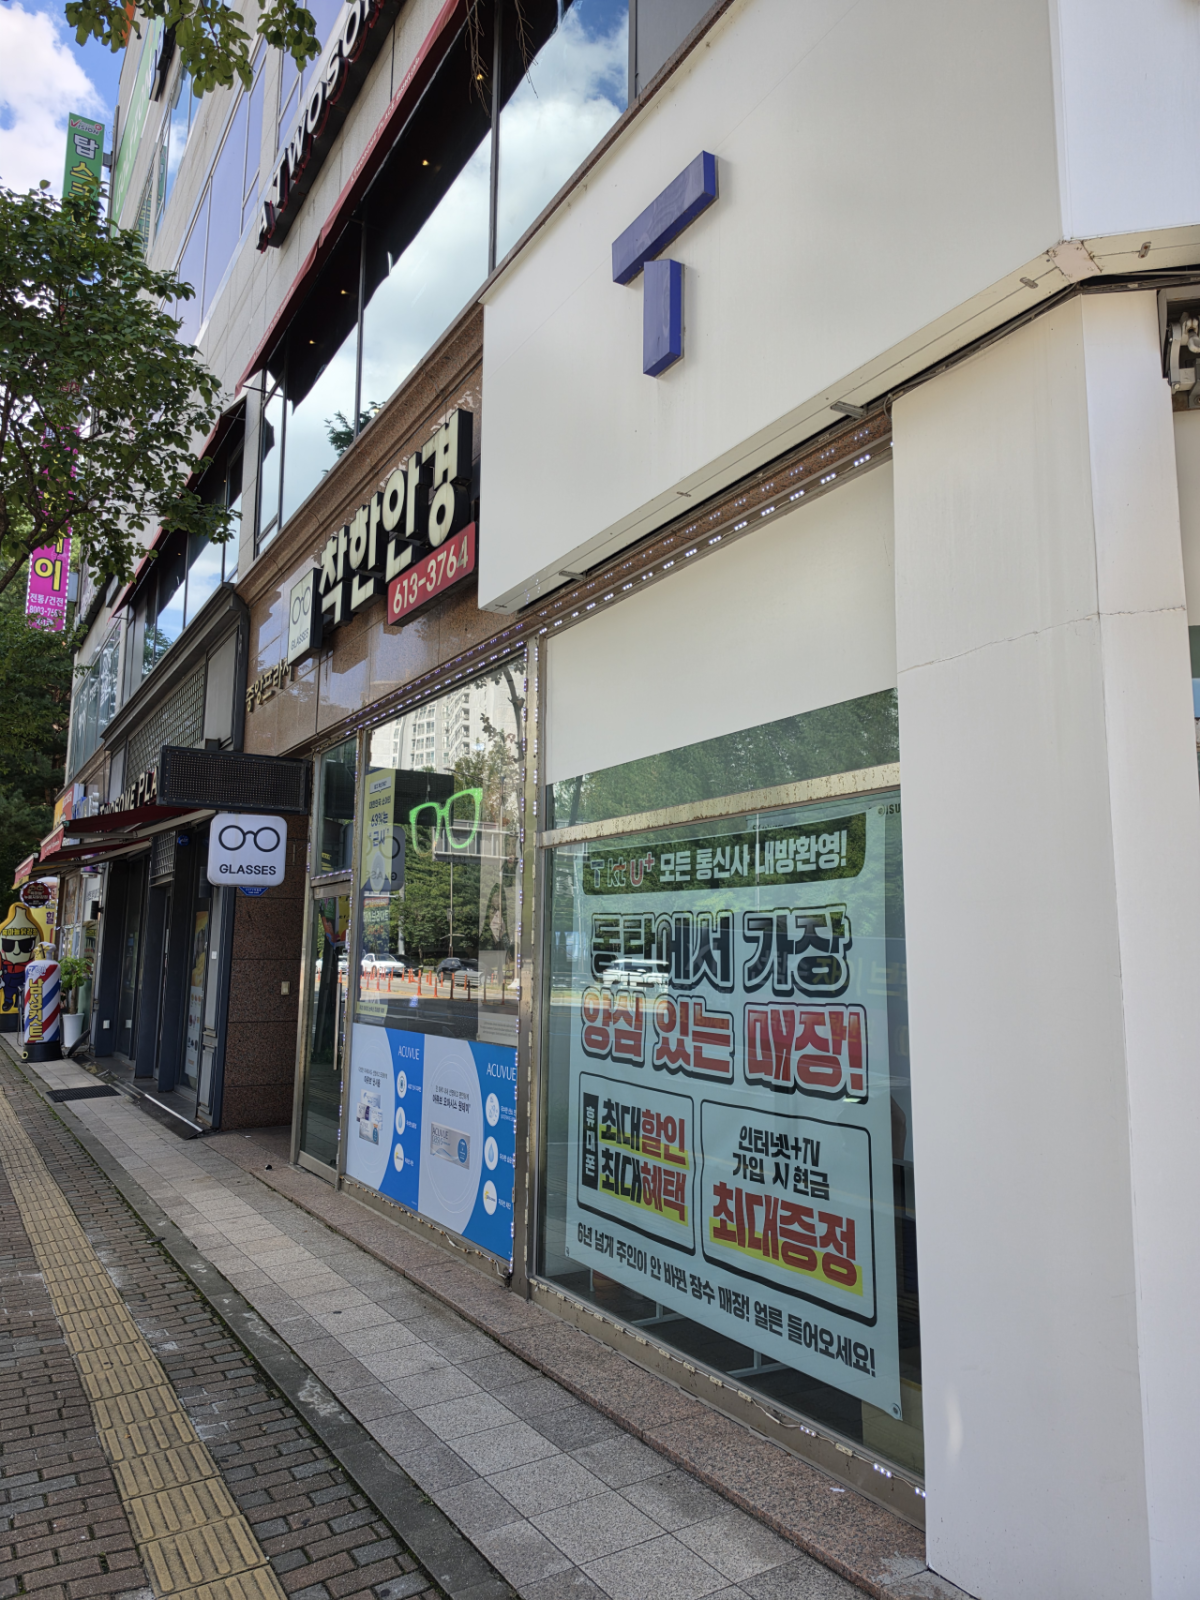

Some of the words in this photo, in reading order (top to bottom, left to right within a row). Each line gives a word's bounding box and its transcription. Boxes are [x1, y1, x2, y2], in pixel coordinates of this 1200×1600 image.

[273, 0, 376, 210] TWOSO
[73, 133, 99, 160] 탑
[318, 408, 466, 625] 착한안경
[393, 535, 468, 614] 613-3764
[219, 864, 277, 876] GLASSES
[660, 851, 692, 883] 모든
[696, 844, 750, 880] 통신사
[755, 829, 847, 875] 내방환영!
[743, 903, 852, 997] 가장
[28, 978, 44, 1041] 남성커트
[581, 986, 646, 1070] 양심
[653, 994, 735, 1085] 있는
[743, 1002, 868, 1104] 매장!
[398, 1045, 420, 1061] ACUVUE
[486, 1062, 517, 1082] ACUVUE
[584, 1105, 597, 1178] 휴대폰
[601, 1098, 686, 1167] 최대할인
[738, 1125, 821, 1168] 인터넷+TV
[601, 1148, 687, 1222] 최대혜택
[732, 1153, 765, 1184] 가입
[772, 1161, 789, 1190] 시
[793, 1166, 830, 1200] 현금
[712, 1181, 857, 1287] 최대증정
[577, 1222, 593, 1248] 6년
[595, 1229, 614, 1259] 넘게
[616, 1242, 648, 1274] 주인이
[650, 1259, 661, 1281] 안
[664, 1261, 688, 1294] 바뀐
[690, 1273, 715, 1306] 장수
[719, 1288, 750, 1321] 매장!
[754, 1302, 783, 1337] 얼른
[787, 1314, 876, 1378] 들어오세요!
